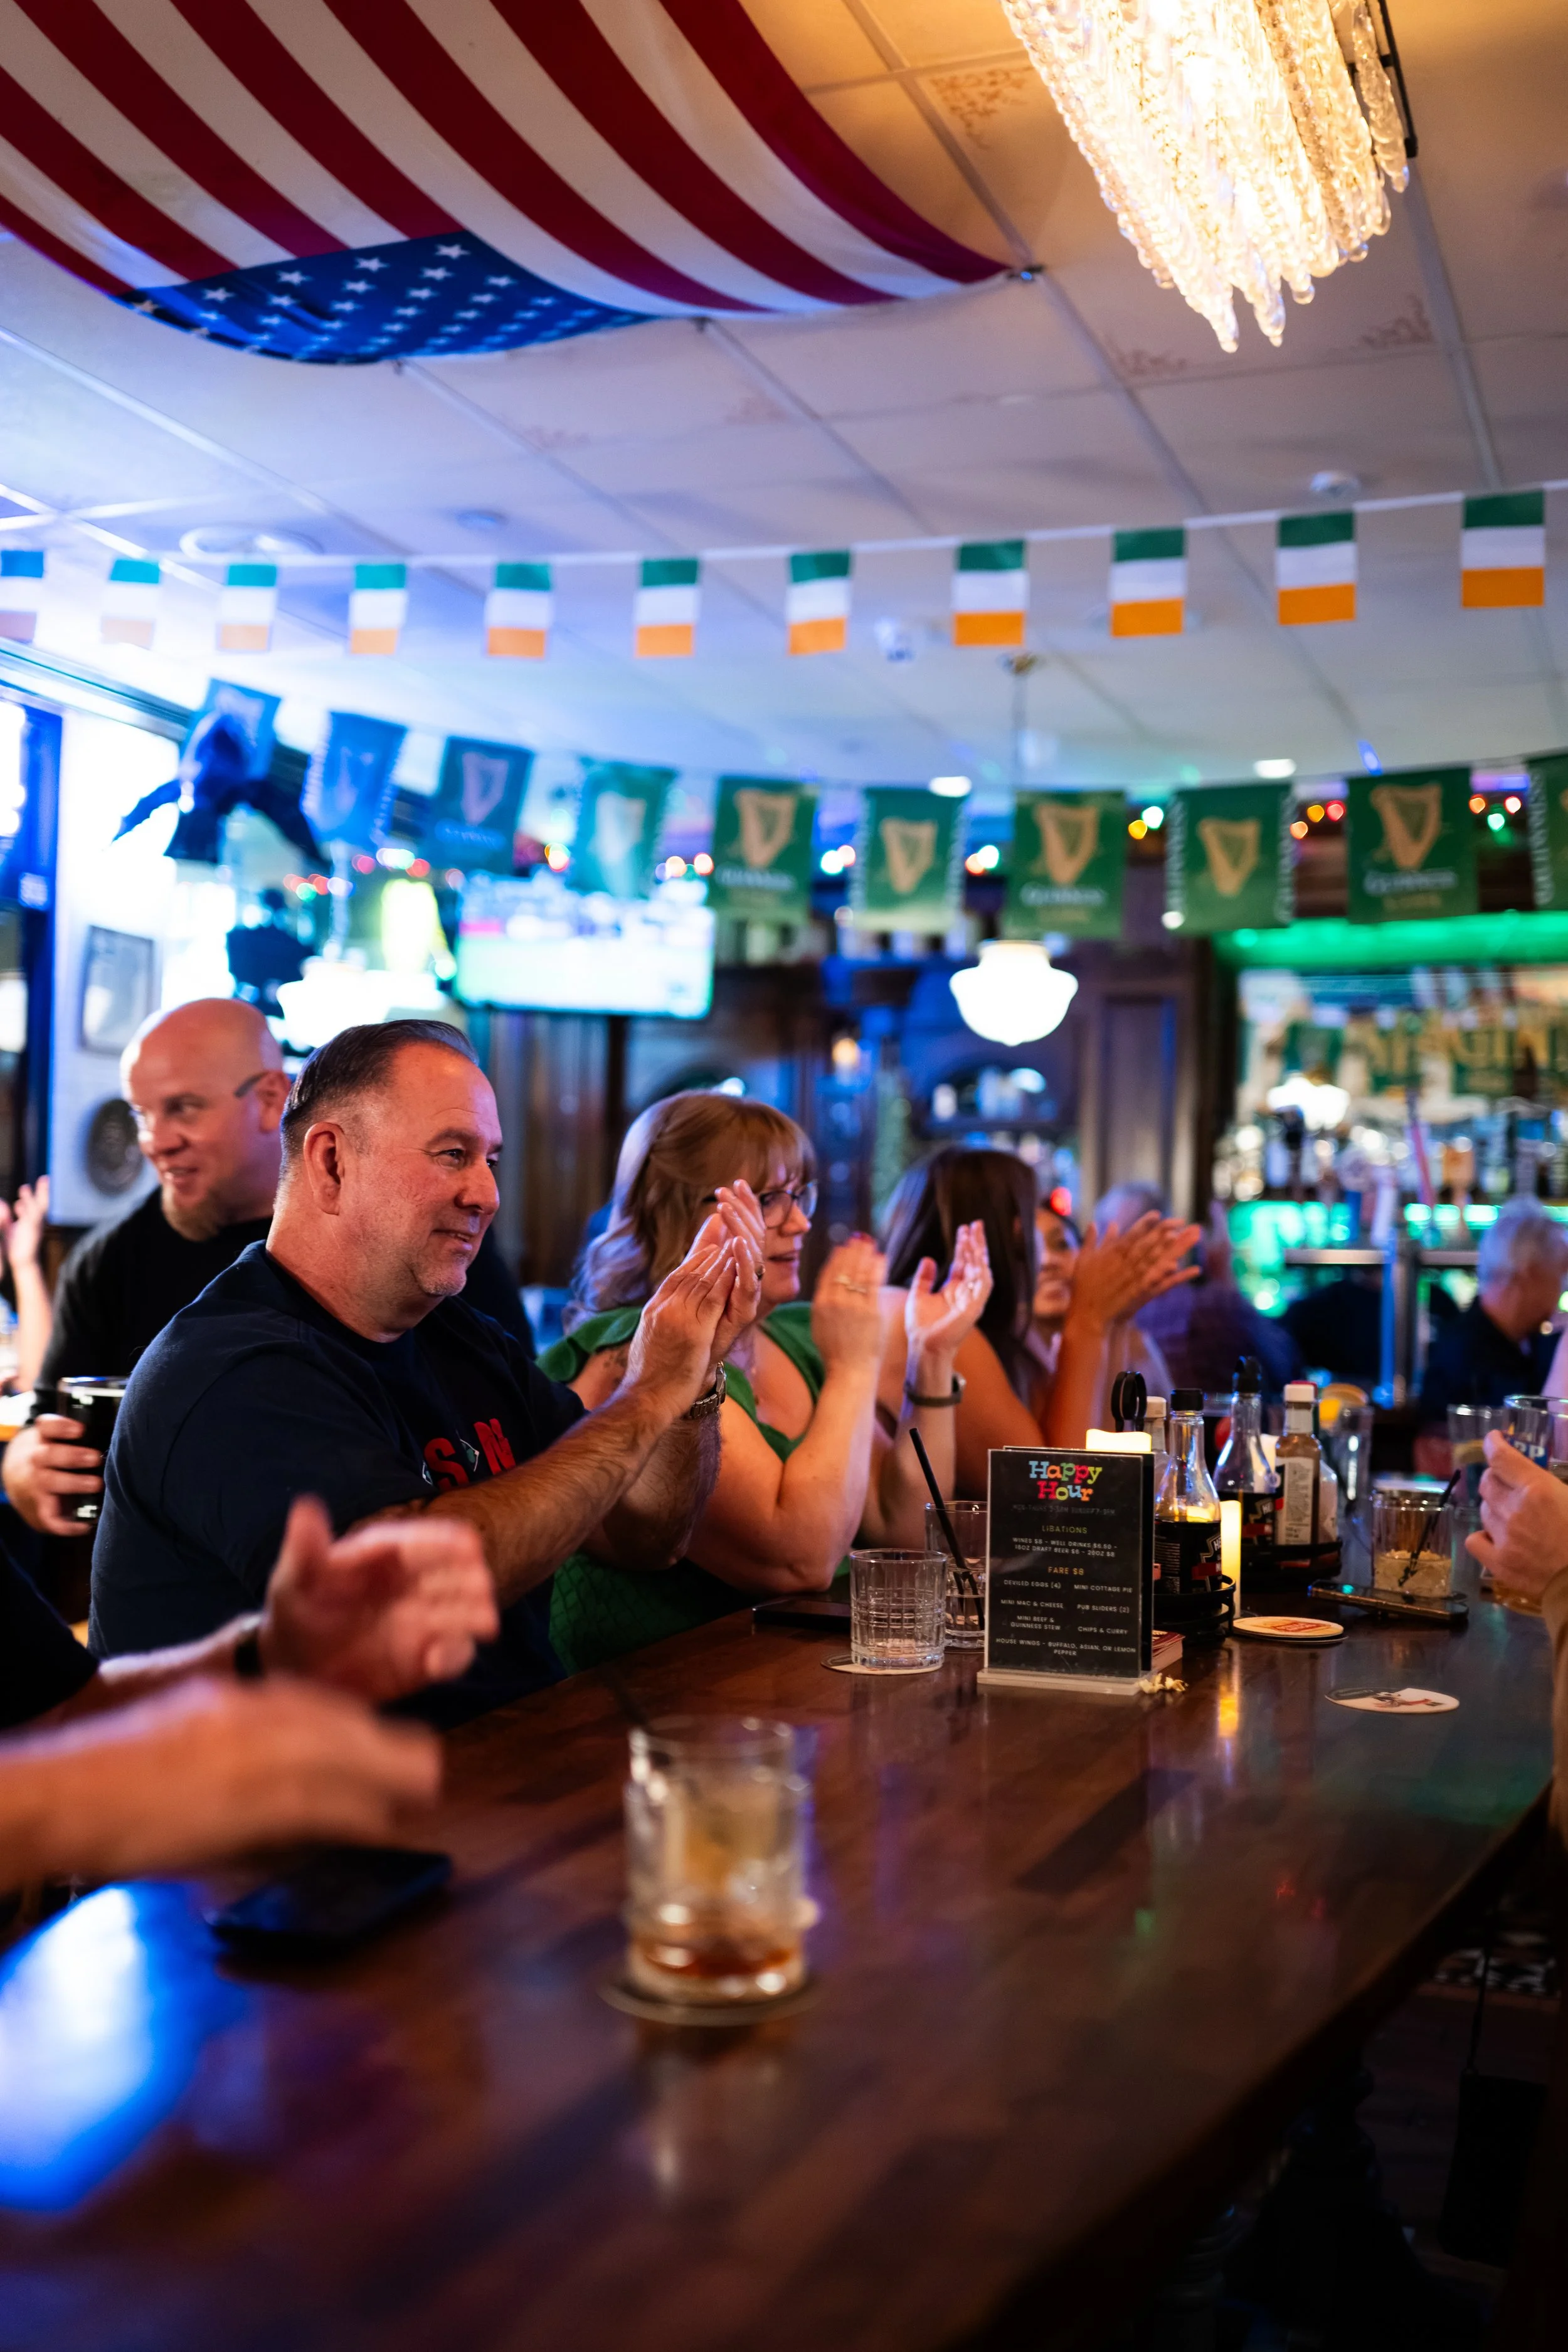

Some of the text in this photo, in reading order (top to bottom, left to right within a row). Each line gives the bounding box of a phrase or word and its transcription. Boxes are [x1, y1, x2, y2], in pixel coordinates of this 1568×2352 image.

[1029, 1460, 1103, 1484] Happy
[1037, 1481, 1094, 1501] Hour
[1042, 1525, 1088, 1535] LIBATIONS
[1048, 1566, 1069, 1575] FARE
